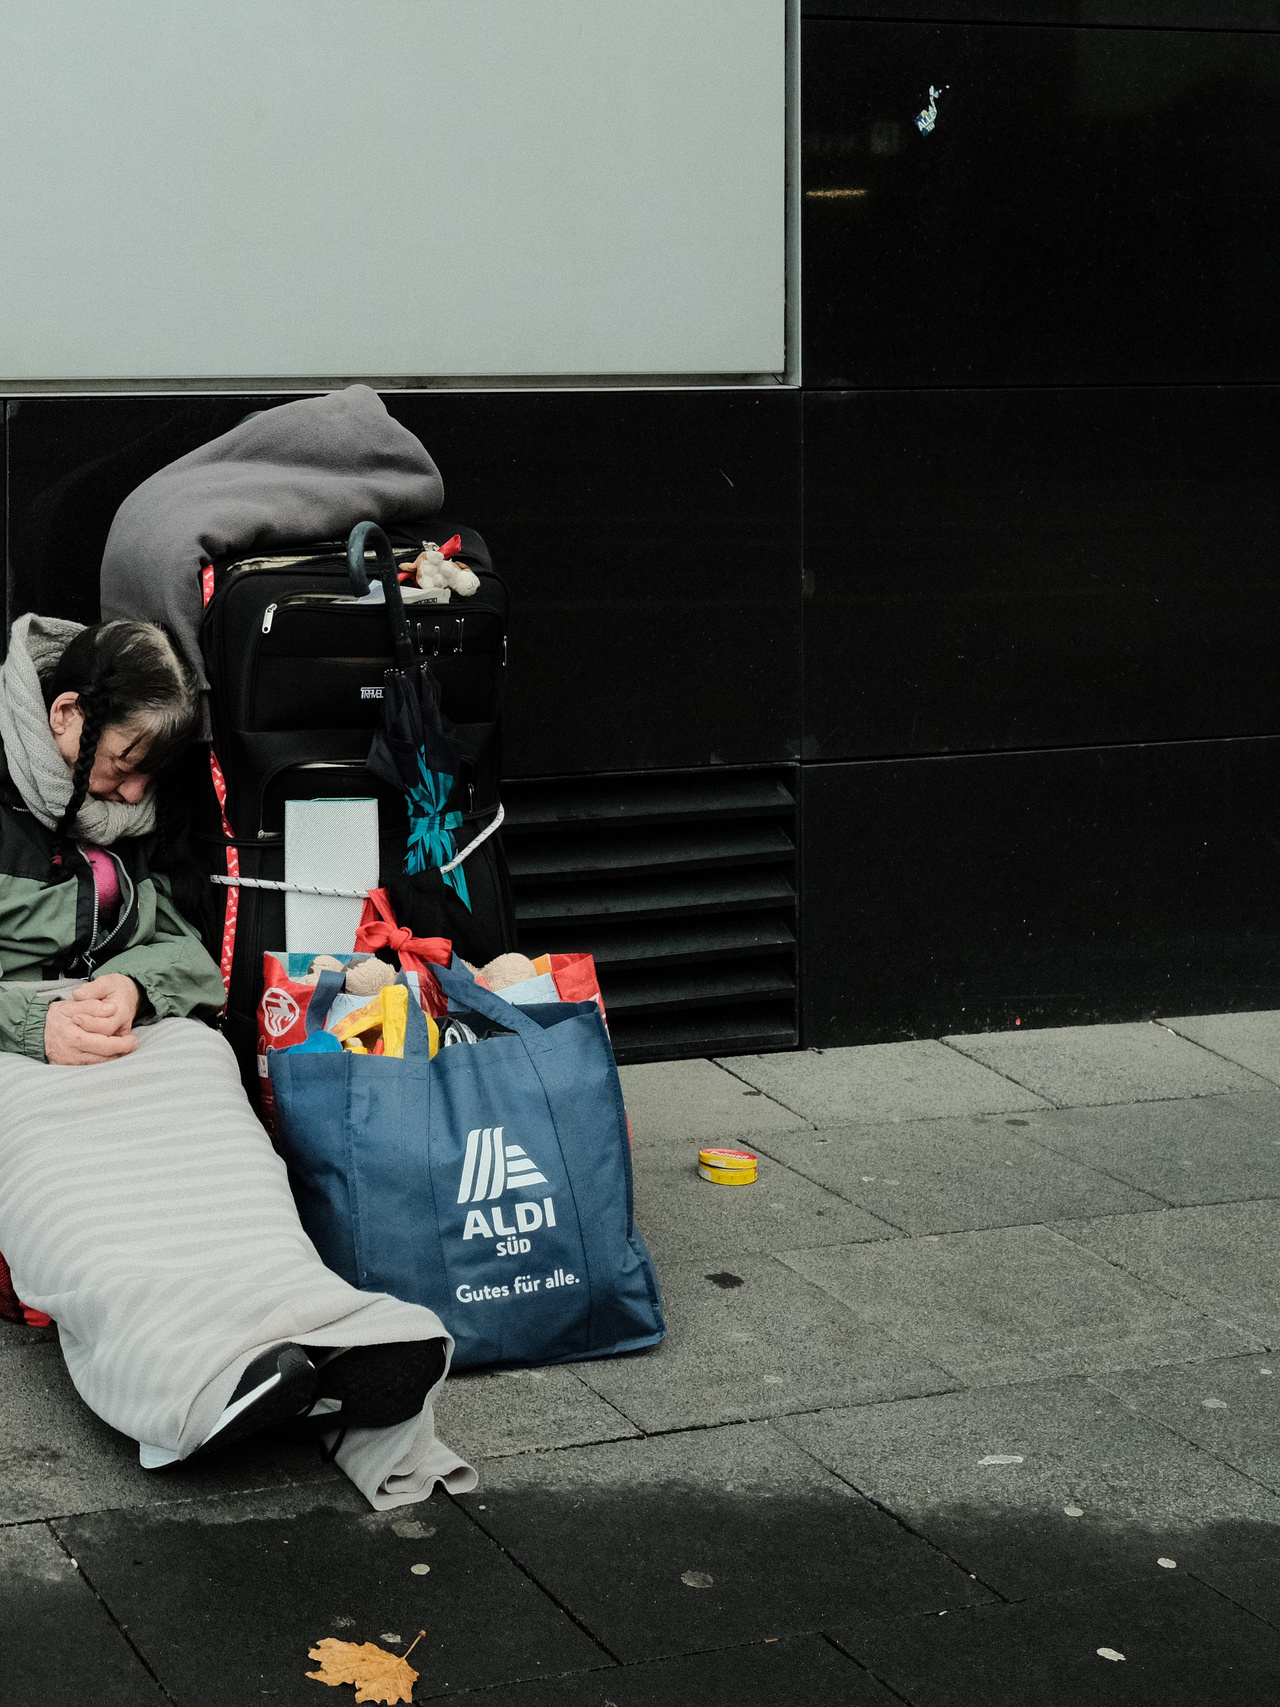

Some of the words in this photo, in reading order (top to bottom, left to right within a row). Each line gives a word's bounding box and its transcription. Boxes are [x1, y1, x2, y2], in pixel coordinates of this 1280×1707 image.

[360, 686, 385, 699] TRAVEL
[462, 1197, 556, 1240] ALDI
[495, 1236, 532, 1257] SÜD
[455, 1284, 510, 1303] Gutes
[513, 1275, 540, 1295] für
[545, 1268, 580, 1289] alle.
